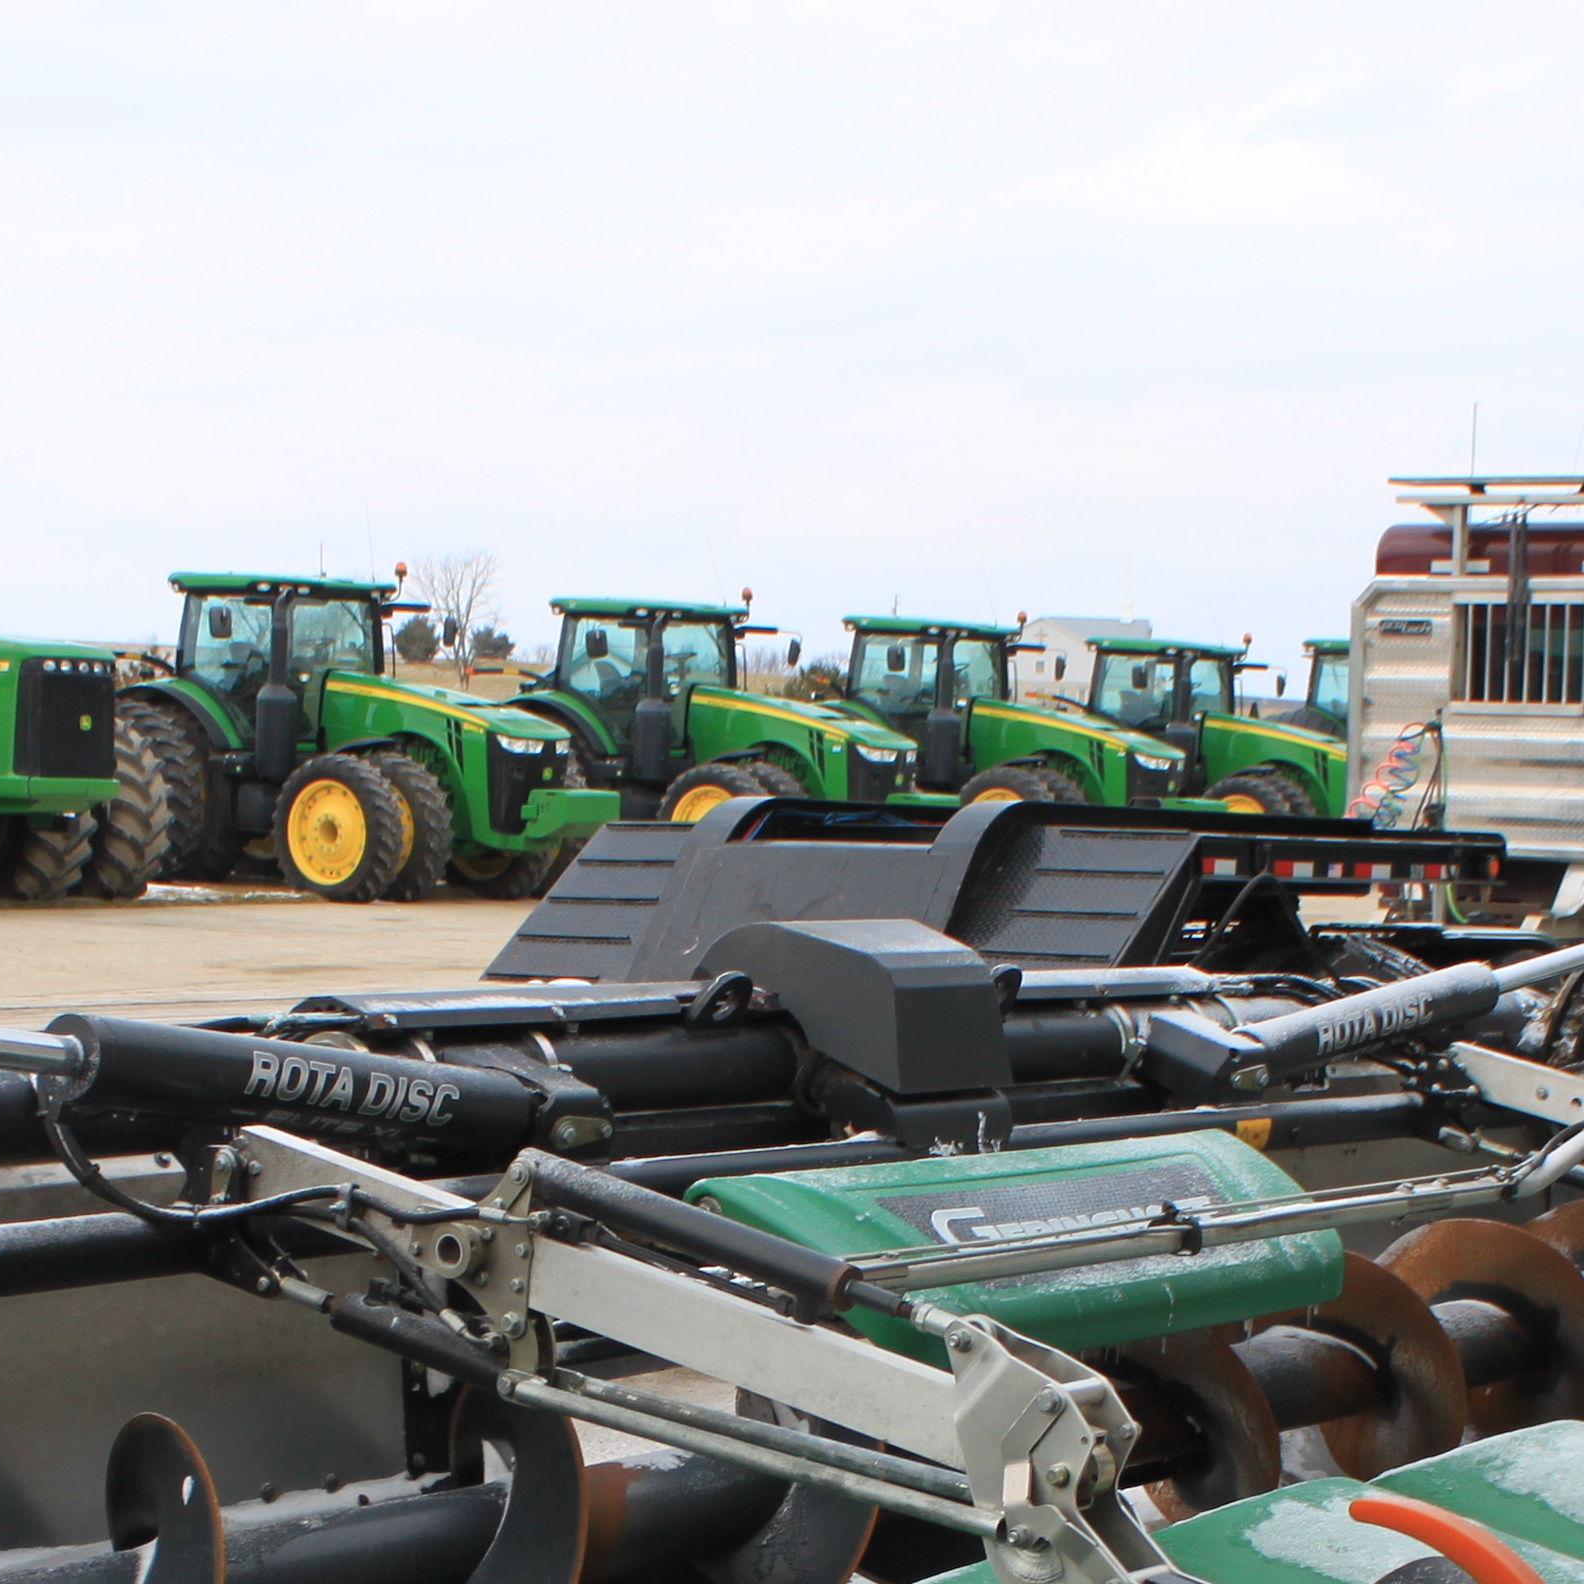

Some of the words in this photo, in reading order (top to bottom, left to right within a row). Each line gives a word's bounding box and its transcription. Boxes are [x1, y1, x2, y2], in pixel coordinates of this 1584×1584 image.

[1316, 1008, 1377, 1056] ROTA
[1379, 990, 1434, 1037] DISC
[243, 1050, 354, 1112] ROTA
[357, 1071, 460, 1127] DISC
[266, 1108, 364, 1134] ELITE
